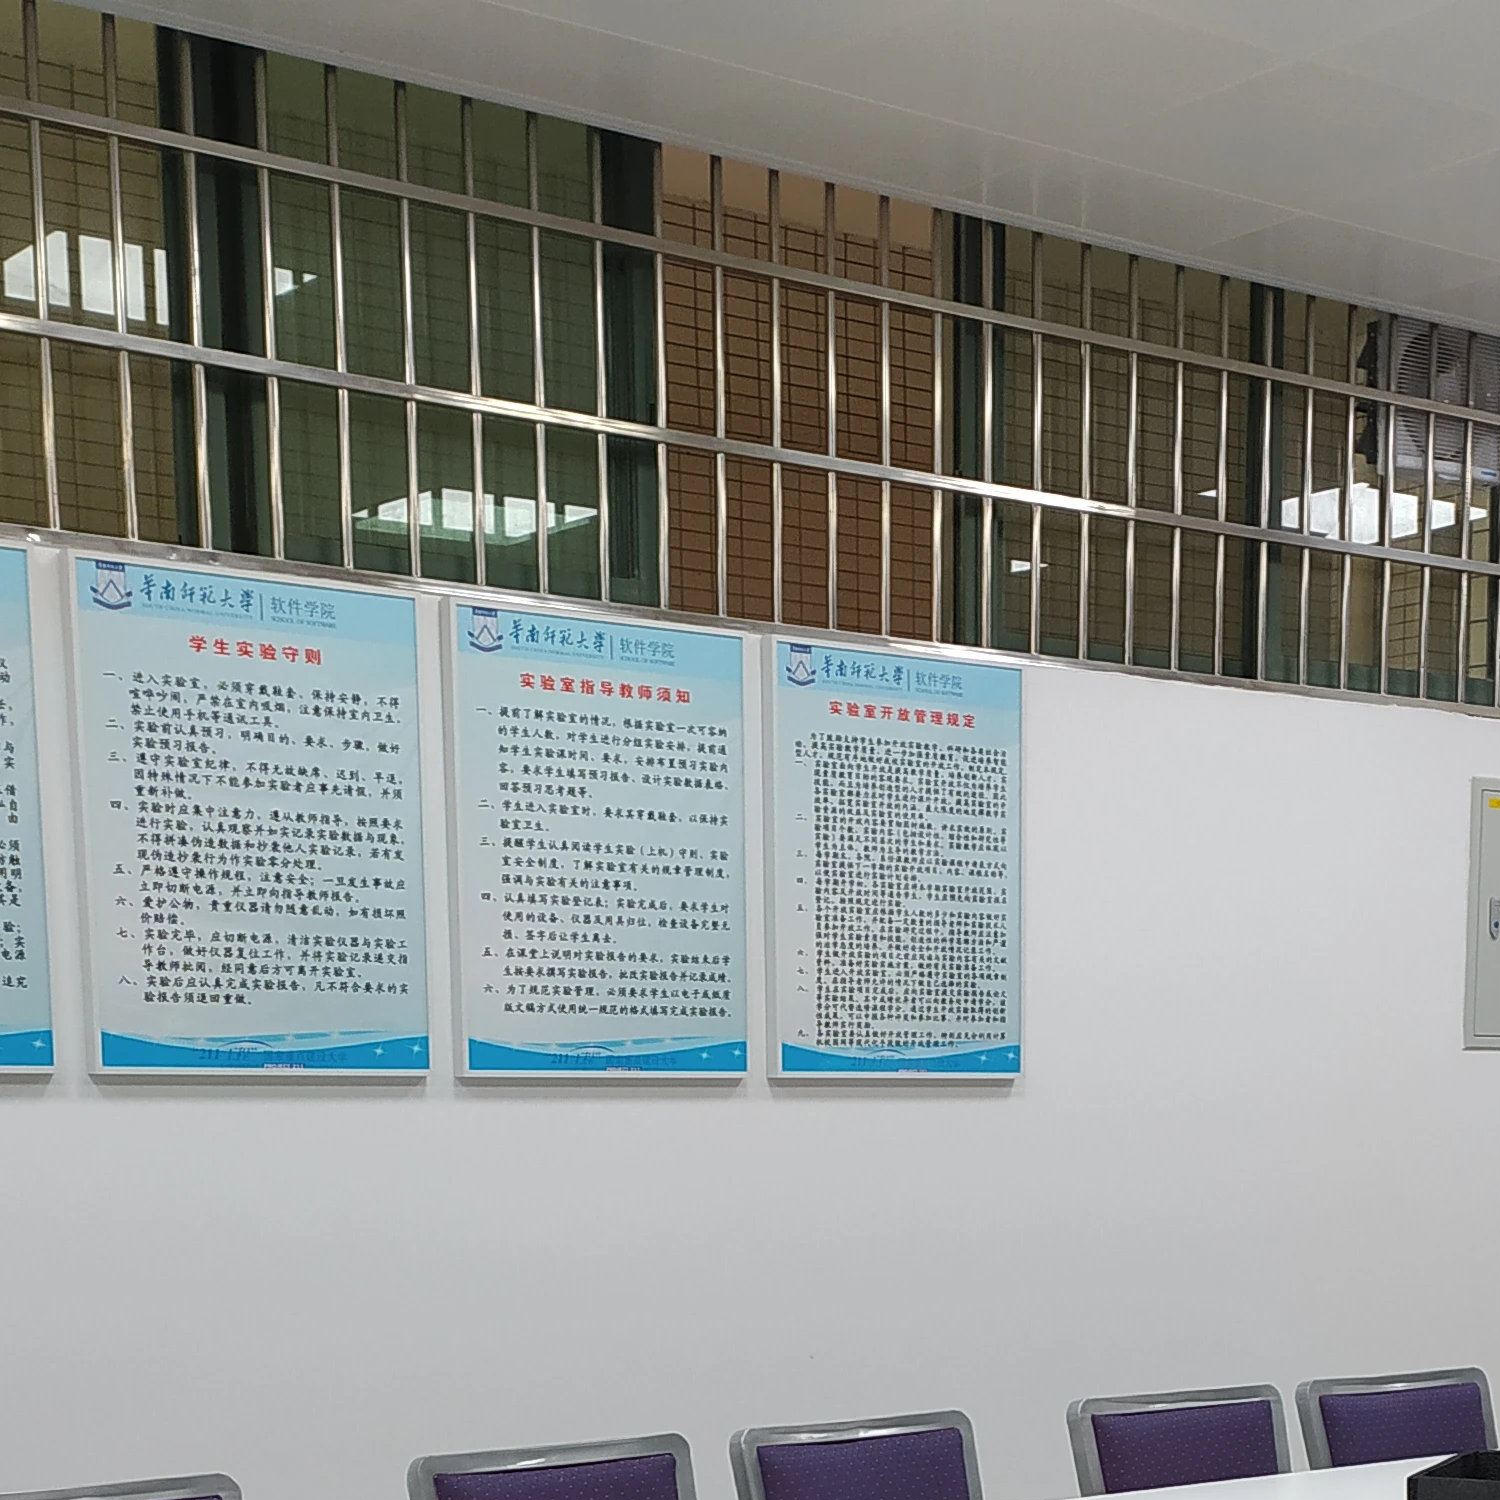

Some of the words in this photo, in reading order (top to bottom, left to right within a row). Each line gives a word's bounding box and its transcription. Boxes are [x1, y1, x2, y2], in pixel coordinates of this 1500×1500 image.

[270, 596, 336, 620] 软件学院
[189, 635, 322, 666] 学生实验守则
[619, 637, 676, 659] 软件学院
[519, 672, 692, 704] 实验室指导教师须知
[915, 670, 964, 690] 软件学院
[829, 700, 976, 729] 实验室开放管理规定
[132, 735, 216, 755] 实验预习报告。
[134, 784, 192, 800] 重新补做。
[140, 912, 185, 926] 价赔偿。
